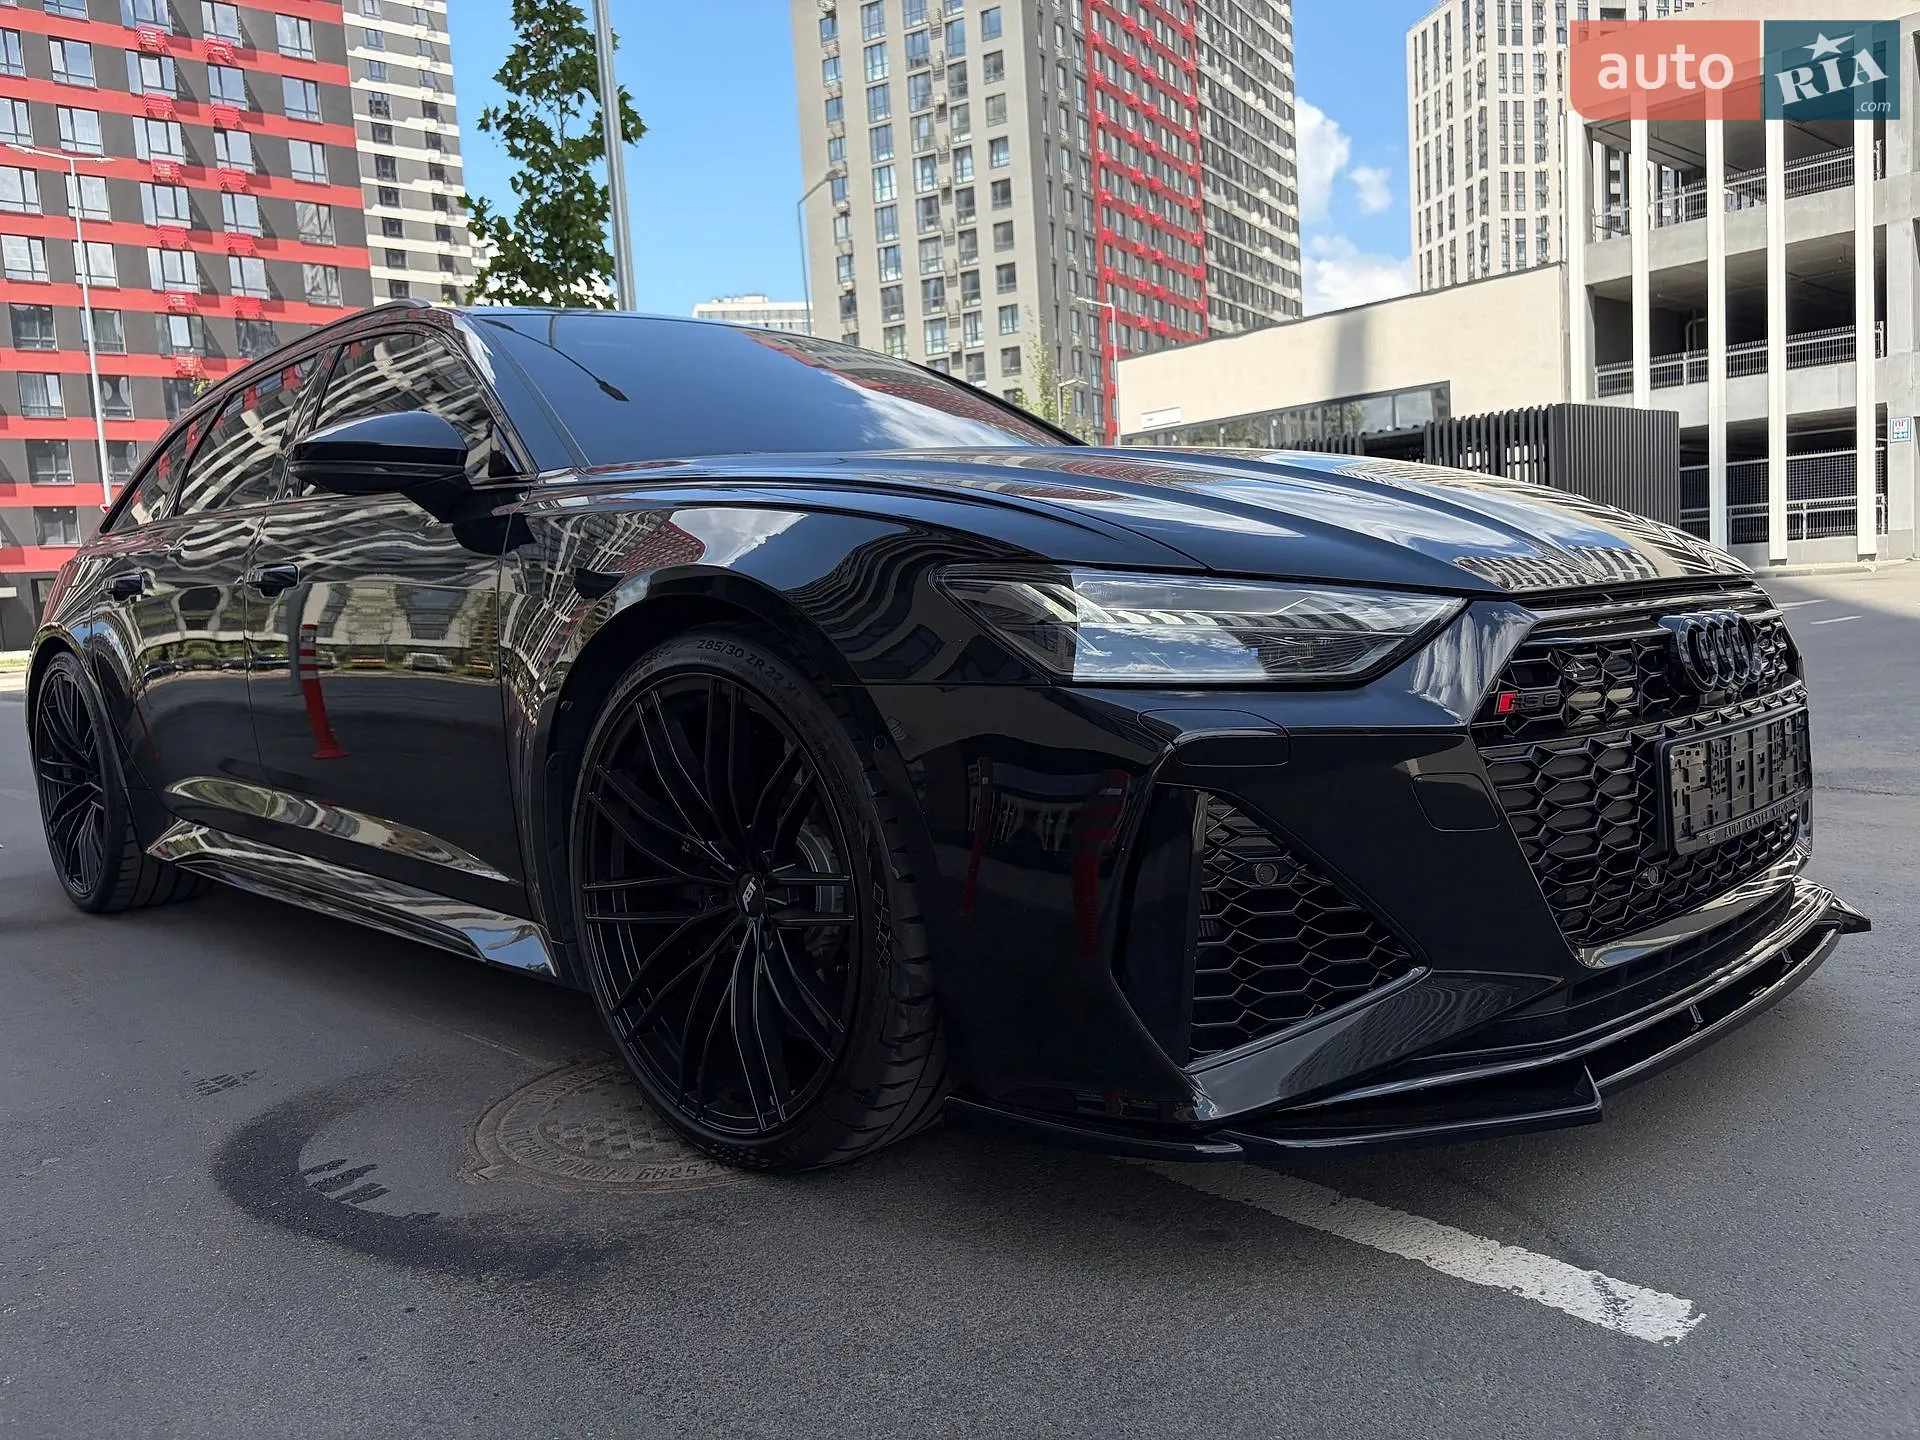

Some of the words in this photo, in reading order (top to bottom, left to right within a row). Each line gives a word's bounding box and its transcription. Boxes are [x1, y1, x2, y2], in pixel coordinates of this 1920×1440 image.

[696, 639, 745, 658] 285/30
[745, 652, 765, 670] ZR
[764, 666, 785, 682] 22
[1725, 822, 1742, 838] AUDI
